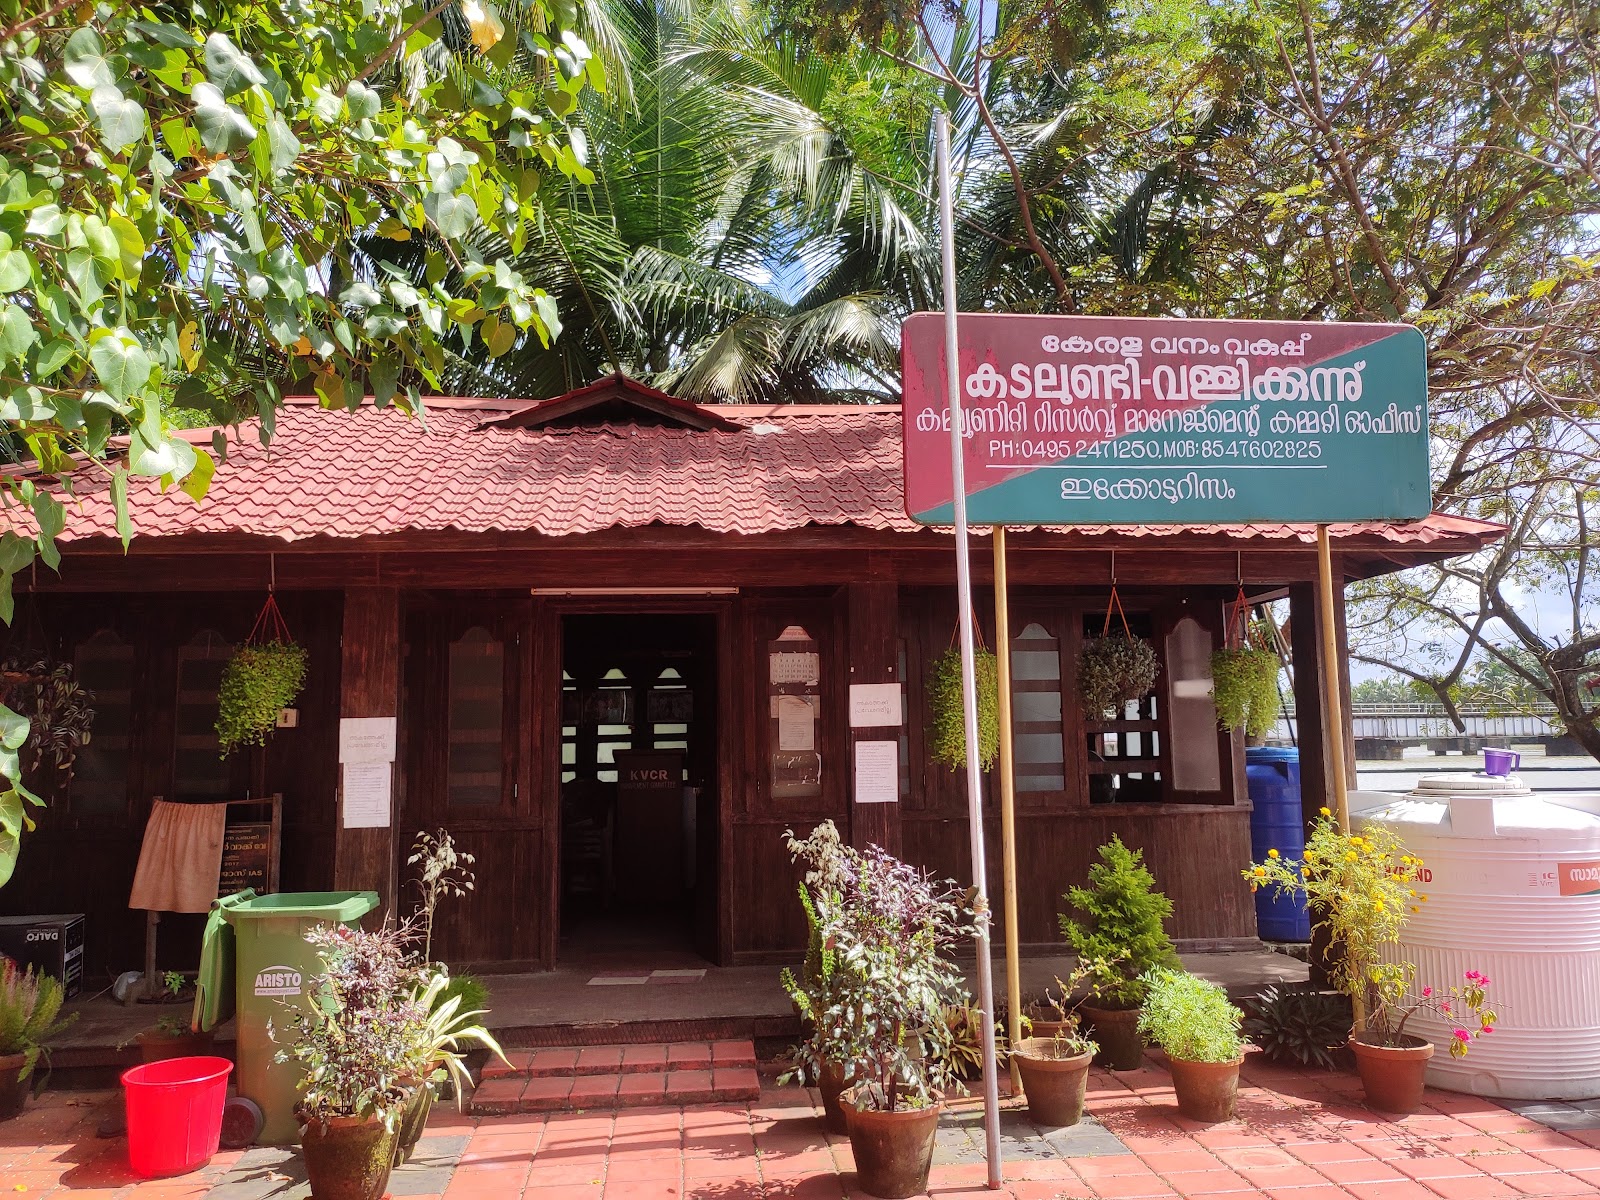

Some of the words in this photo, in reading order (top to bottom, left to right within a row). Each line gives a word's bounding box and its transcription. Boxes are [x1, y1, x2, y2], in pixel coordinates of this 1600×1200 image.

[1041, 335, 1143, 357] കേരള
[1150, 336, 1219, 355] വനം
[1223, 332, 1312, 357] വകുപ്പ്
[630, 769, 668, 781] KVCR
[26, 932, 59, 942] DALFO
[254, 972, 302, 988] ARISTO
